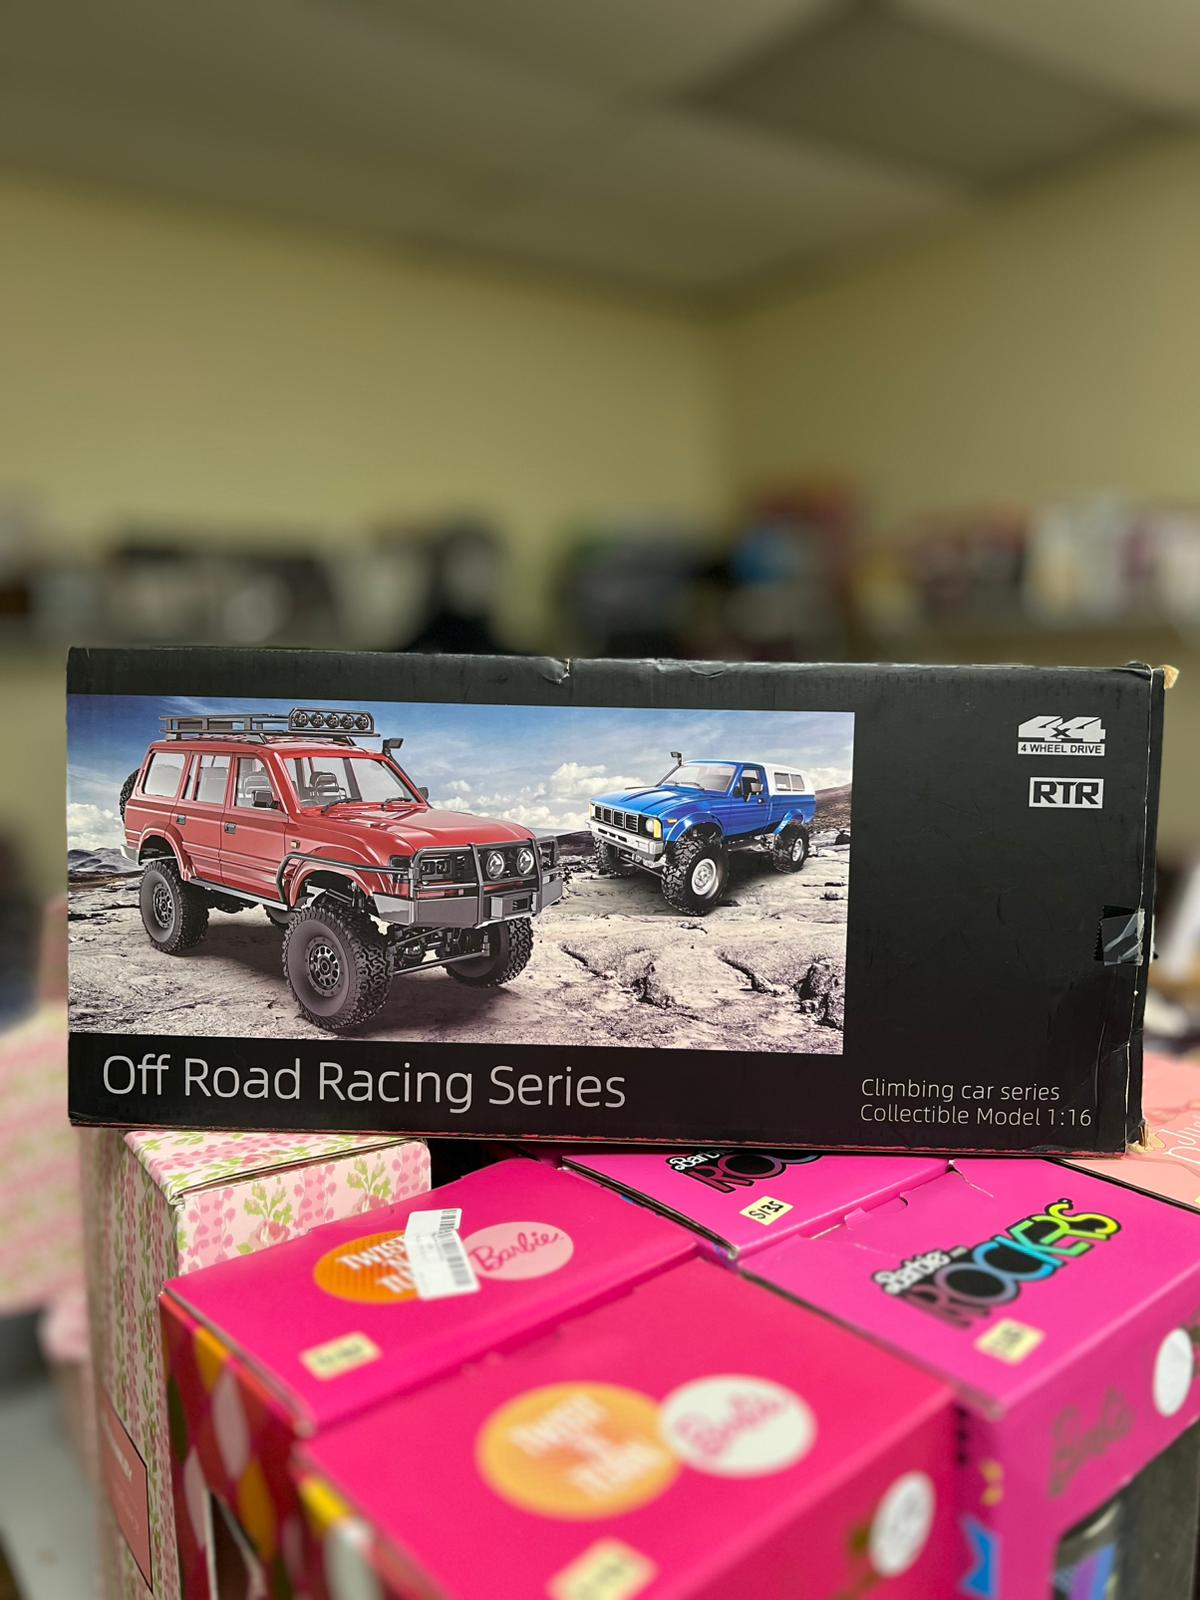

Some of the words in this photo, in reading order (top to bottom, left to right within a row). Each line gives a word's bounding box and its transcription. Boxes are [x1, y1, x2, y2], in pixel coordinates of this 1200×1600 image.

[1021, 744, 1027, 752] 4
[1030, 744, 1067, 753] WHEEL
[1070, 744, 1102, 754] DRIVE
[1033, 781, 1099, 804] RTR
[102, 1053, 171, 1096] Off
[184, 1057, 301, 1100] Road
[319, 1061, 473, 1114] Racing
[488, 1065, 626, 1108] Series
[861, 1077, 954, 1102] Climbing
[961, 1084, 995, 1100] car
[1000, 1083, 1060, 1101] series
[860, 1104, 969, 1125] Collectible
[976, 1107, 1041, 1126] Model
[1048, 1108, 1092, 1127] 1:16
[468, 1231, 560, 1272] Barbie
[898, 1199, 1121, 1328] ROCKERS
